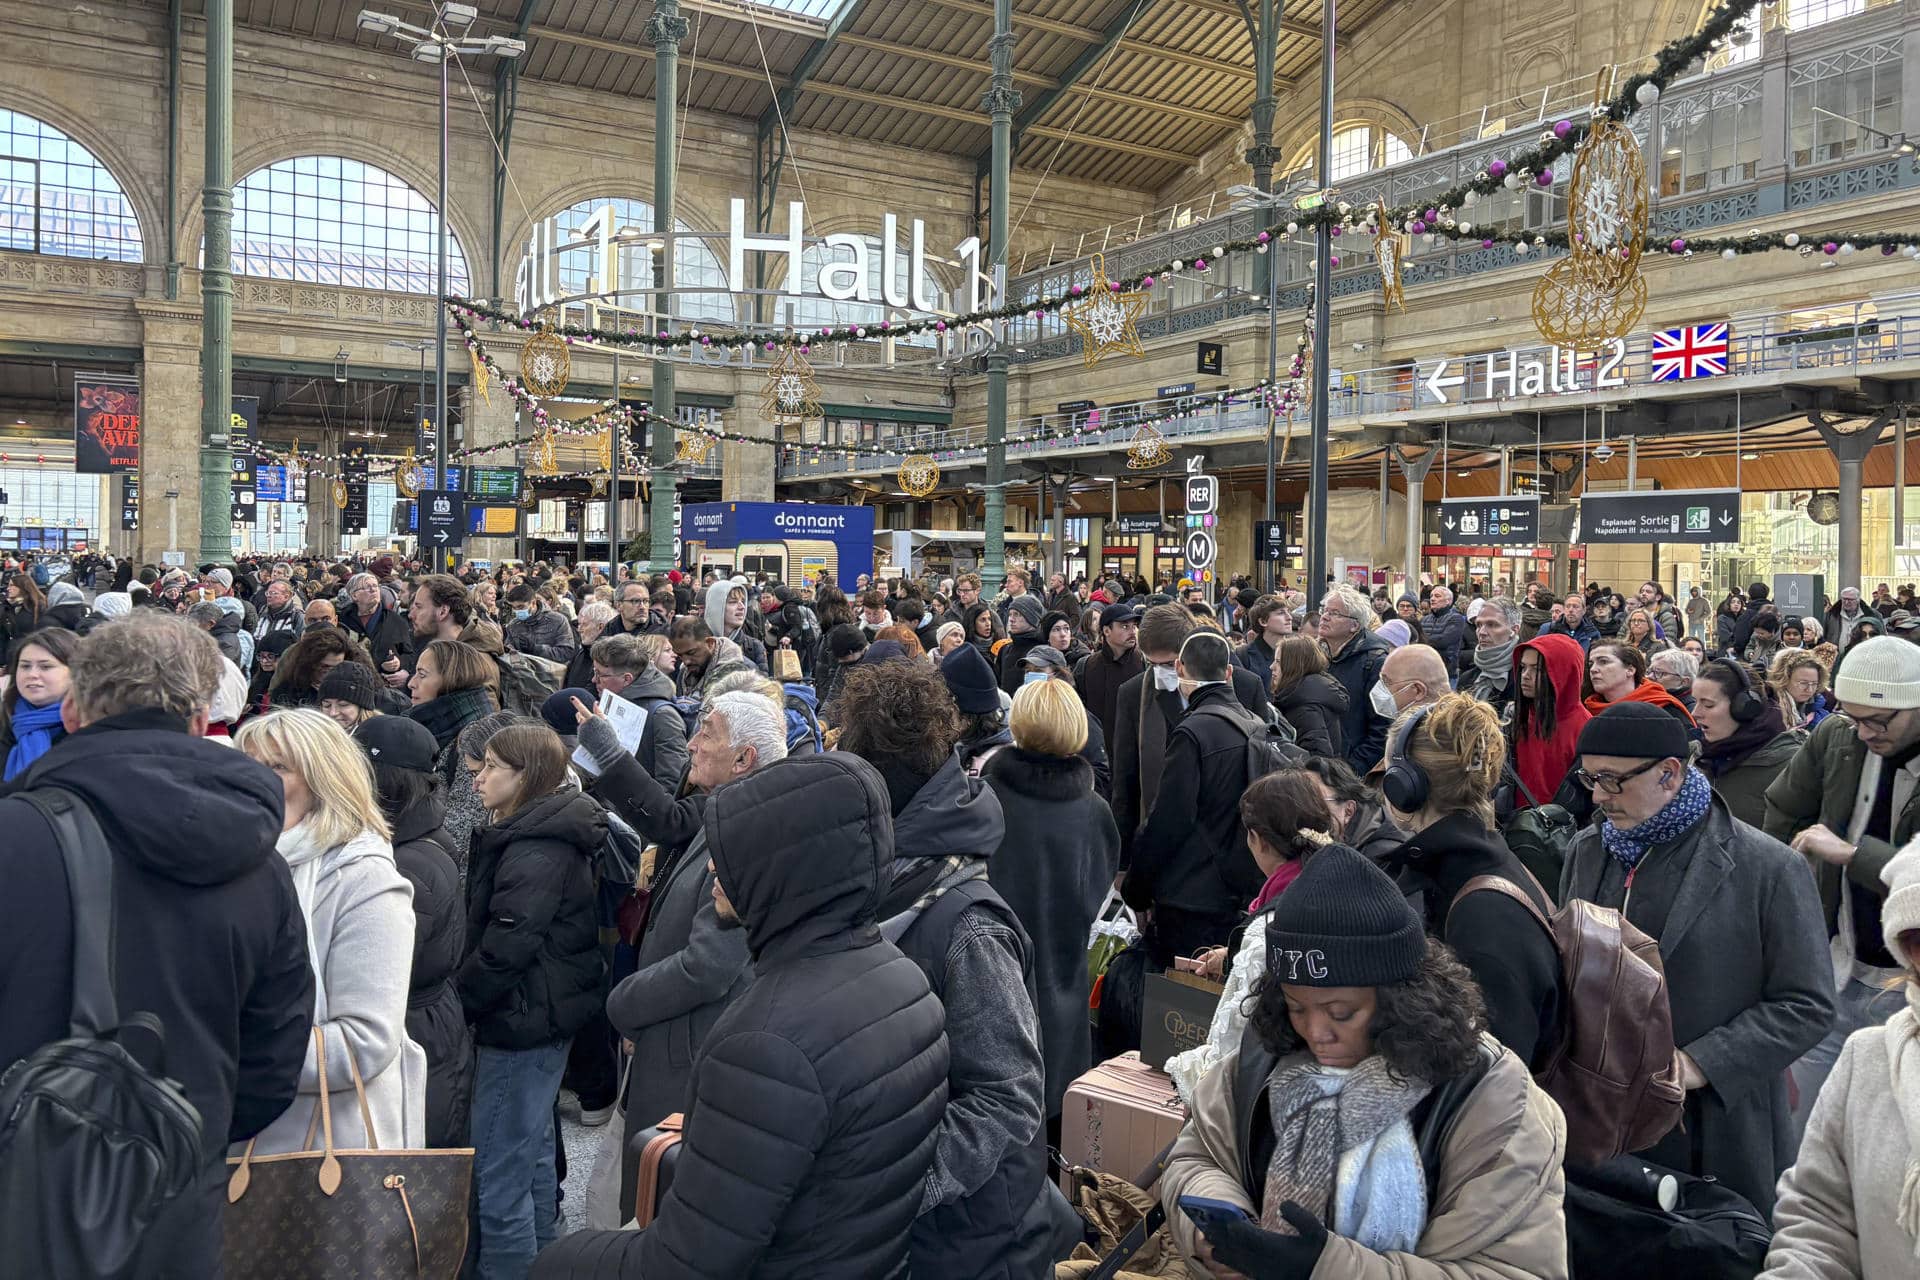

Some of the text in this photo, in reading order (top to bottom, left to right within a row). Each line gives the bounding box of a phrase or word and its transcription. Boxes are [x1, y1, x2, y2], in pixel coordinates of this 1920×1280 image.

[579, 206, 616, 296] 1
[729, 198, 981, 314] Hall 1
[1486, 338, 1626, 399] Hall 2
[1190, 487, 1209, 502] RER
[694, 512, 723, 526] donnant
[774, 512, 845, 527] donnant
[1601, 518, 1637, 527] Esplanade
[1640, 515, 1670, 525] Sortie
[1594, 527, 1628, 535] Napoléon
[1192, 539, 1206, 560] M
